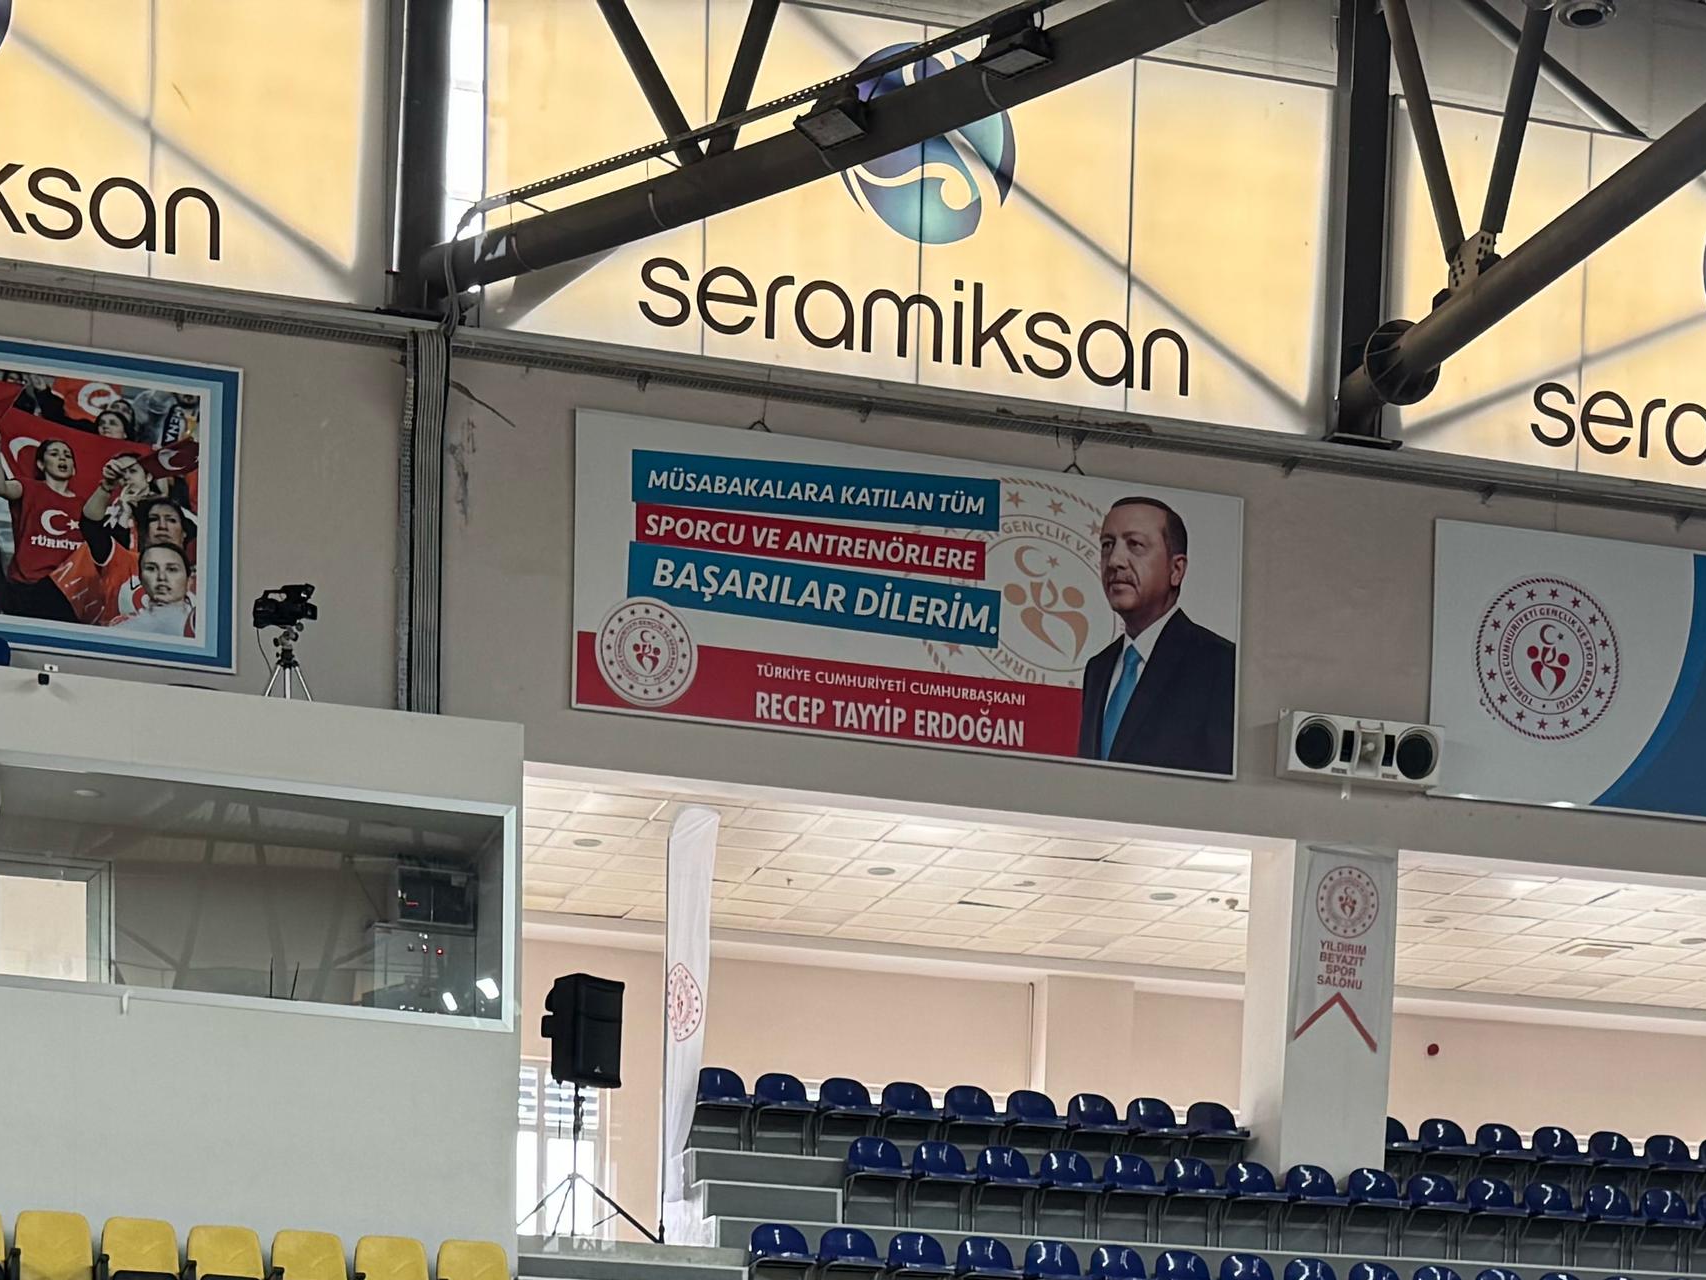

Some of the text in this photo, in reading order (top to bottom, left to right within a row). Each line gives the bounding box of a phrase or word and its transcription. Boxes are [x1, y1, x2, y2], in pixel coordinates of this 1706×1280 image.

[637, 257, 1189, 396] seramiksan
[648, 467, 985, 516] MÜSABAKALARA KATILAN TÜM
[645, 514, 976, 571] SPORCU VE ANTRENÖRLERE
[653, 558, 997, 635] BAŞARILAR DİLERİM.
[757, 663, 1025, 706] TÜRKİYE CUMHURİYETİ CUMHURBAŞKANI
[755, 692, 1024, 747] RECEP TAYYİP ERDOĞAN
[1320, 940, 1367, 956] YILDIRIM
[1320, 952, 1365, 967] BEYAZIT
[1326, 964, 1356, 978] SPOR
[1317, 975, 1363, 990] SALONU
